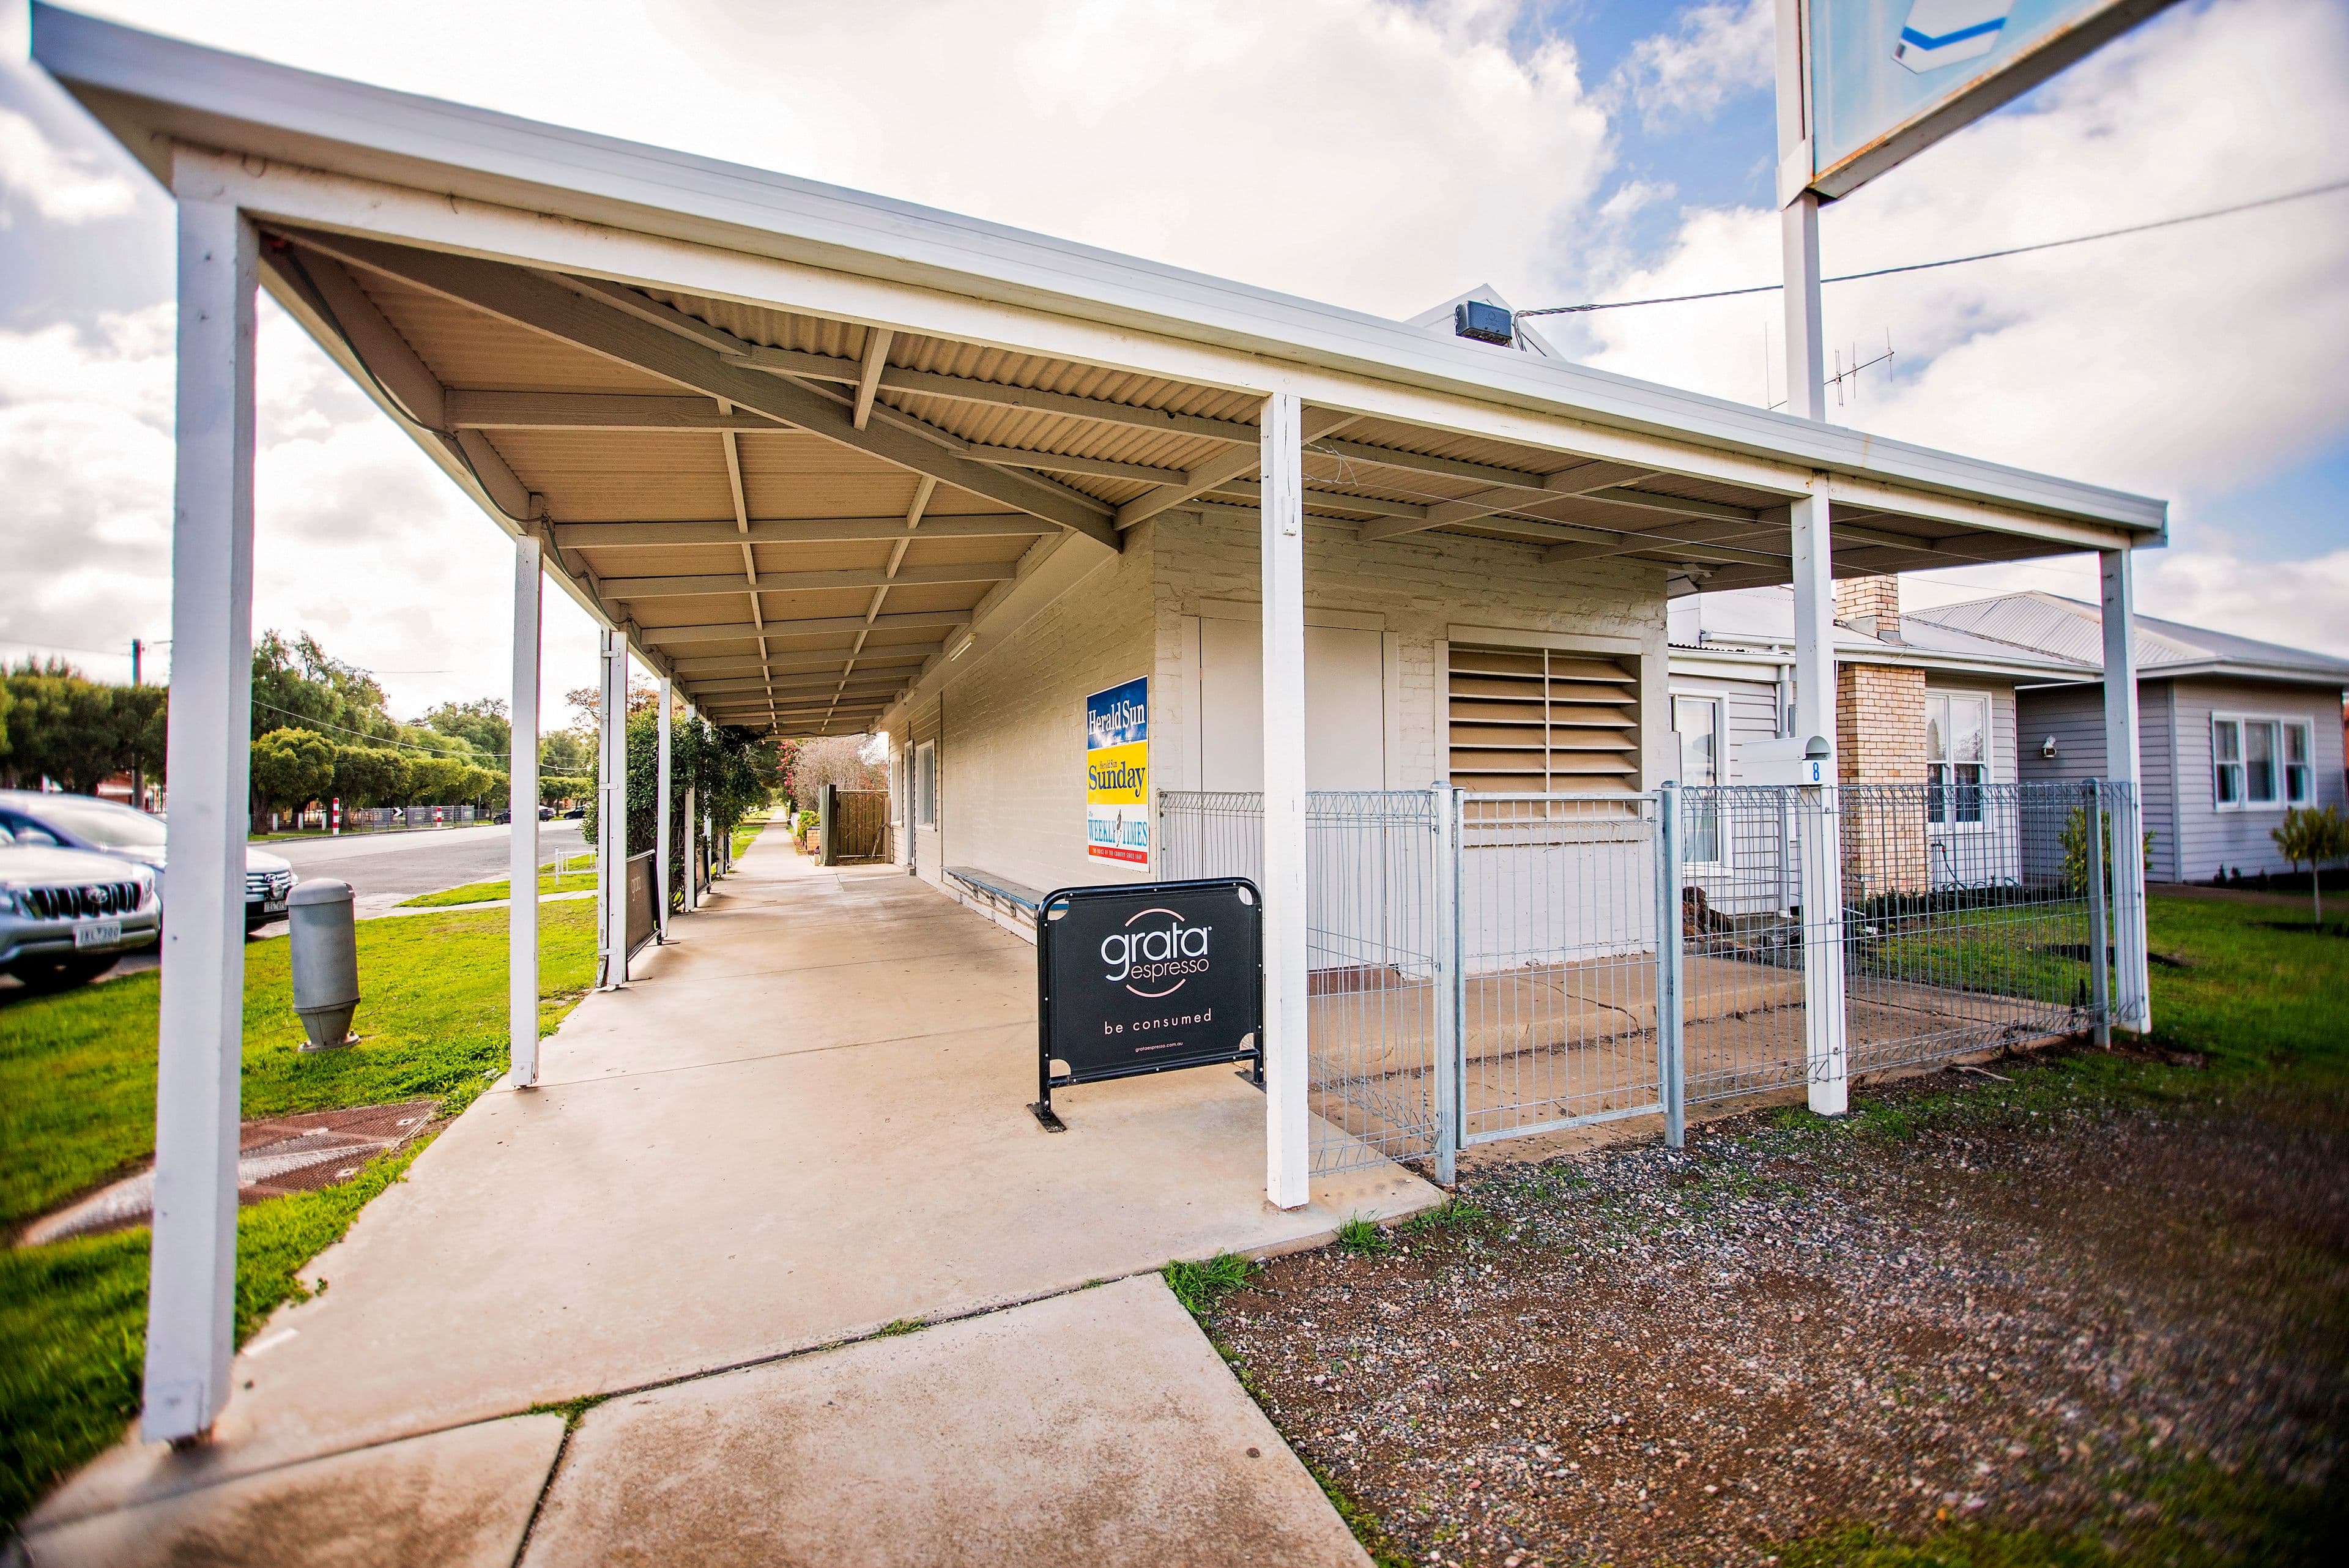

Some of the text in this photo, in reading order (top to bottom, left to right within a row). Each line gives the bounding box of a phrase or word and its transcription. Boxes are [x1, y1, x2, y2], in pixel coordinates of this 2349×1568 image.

[1088, 699, 1145, 735] Herald Sun
[1089, 762, 1145, 797] Sunday
[1813, 762, 1820, 781] 8
[1088, 819, 1148, 847] WEEKLY TIMES
[1101, 922, 1209, 981] grata
[1130, 957, 1209, 983] espresso
[1105, 1008, 1212, 1035] be consumed
[1135, 1042, 1183, 1053] grataespresso.com.au
